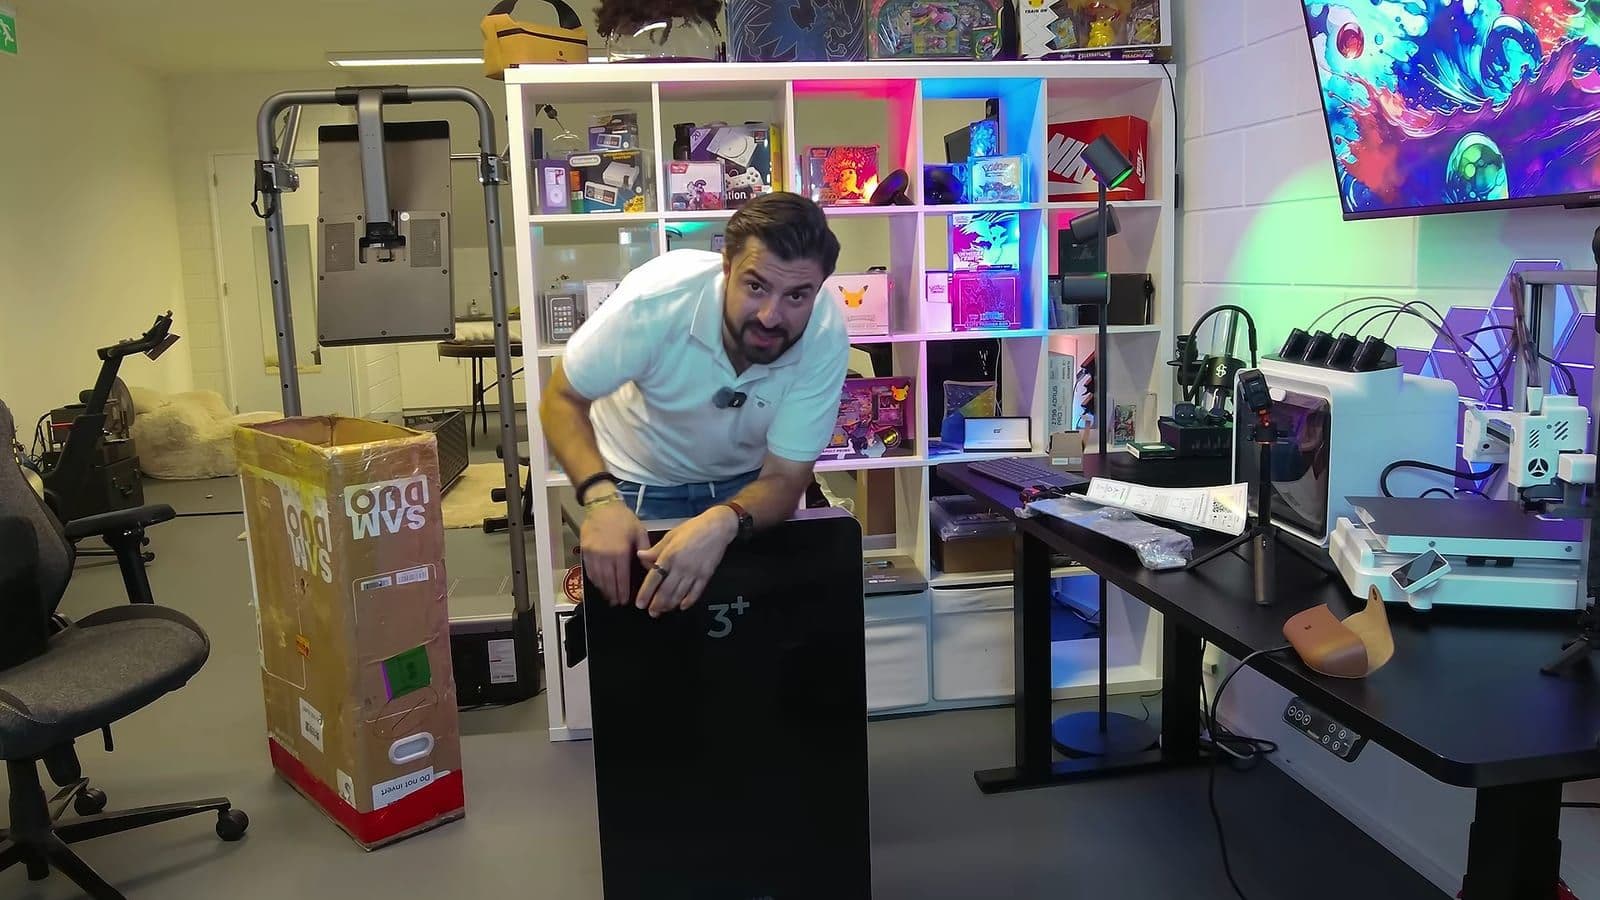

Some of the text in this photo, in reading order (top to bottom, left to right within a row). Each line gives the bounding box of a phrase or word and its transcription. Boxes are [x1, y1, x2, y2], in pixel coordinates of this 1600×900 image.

[350, 480, 425, 515] DUO
[286, 505, 328, 549] DUO
[351, 506, 426, 539] SAM
[290, 534, 332, 583] SAM
[380, 774, 431, 797] Do not invert
